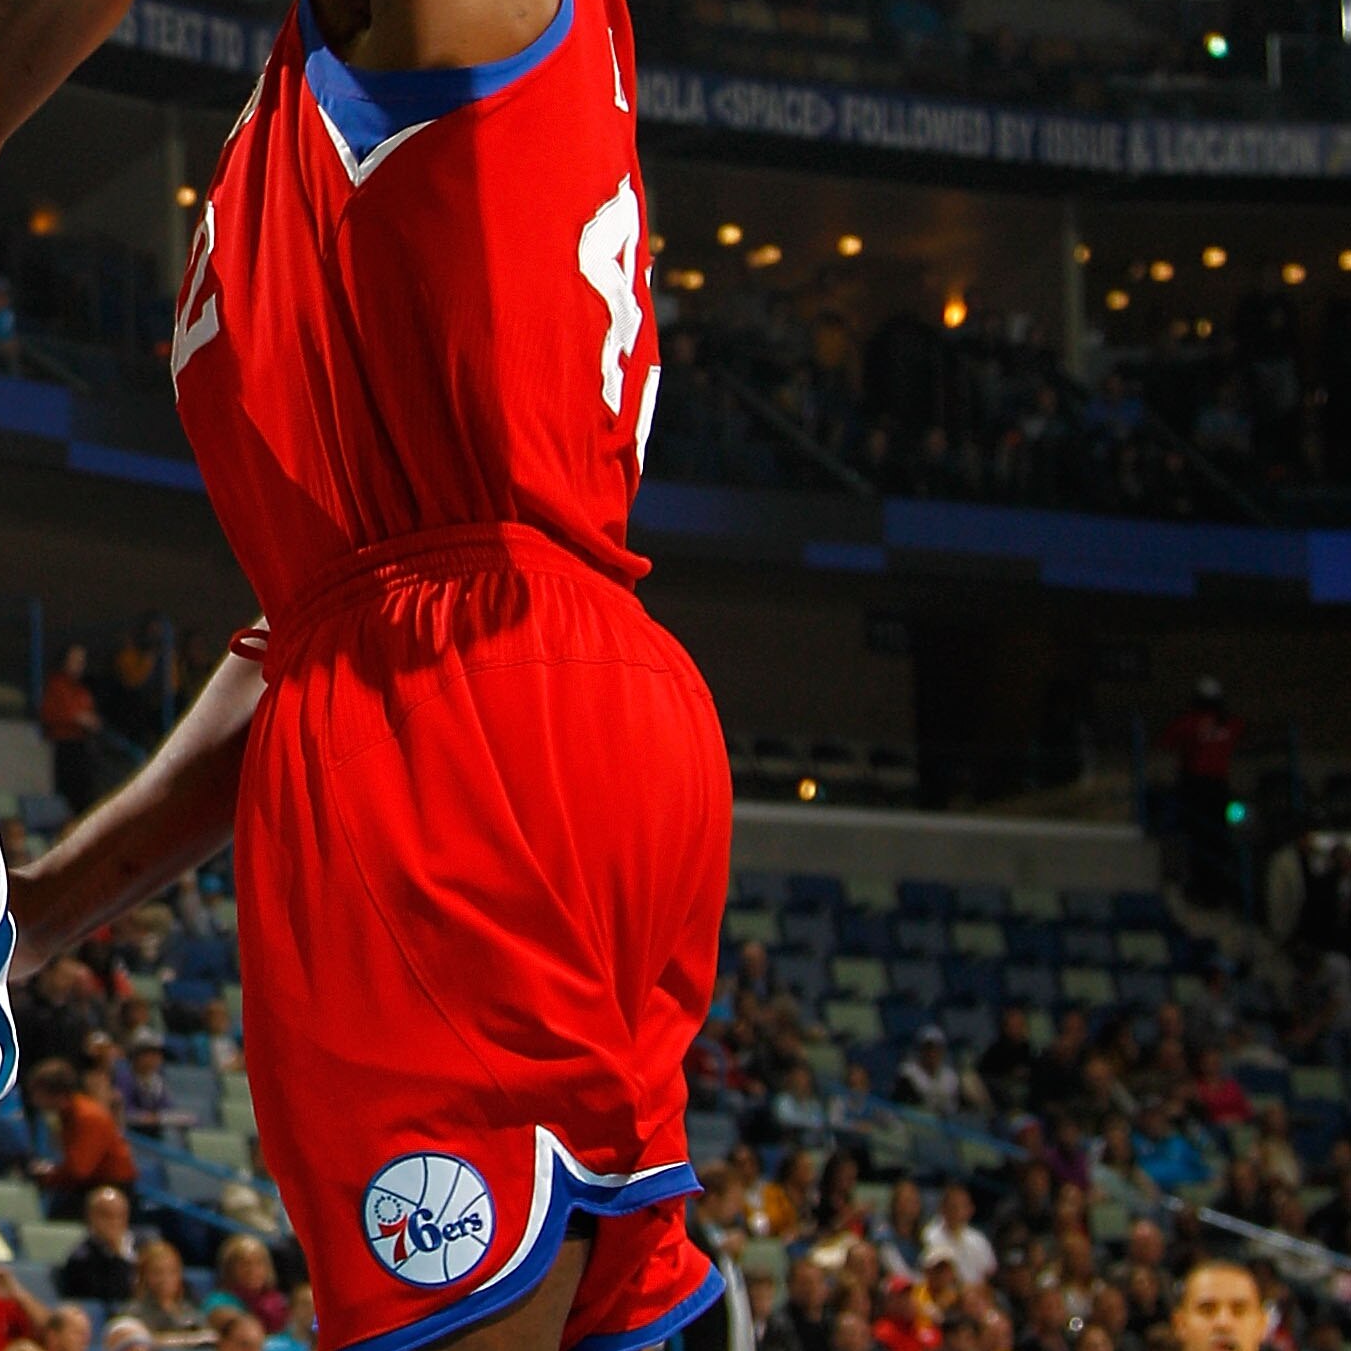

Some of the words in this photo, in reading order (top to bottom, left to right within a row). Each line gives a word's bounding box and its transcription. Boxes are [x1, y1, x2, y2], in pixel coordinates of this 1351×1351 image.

[142, 0, 204, 62] TEXT
[210, 15, 245, 71] TO
[840, 93, 993, 157] FOLLOWED
[994, 109, 1034, 161] BY
[1040, 115, 1123, 170] ISSUE
[1156, 120, 1321, 178] LOCATION
[378, 1208, 484, 1265] 76ers
